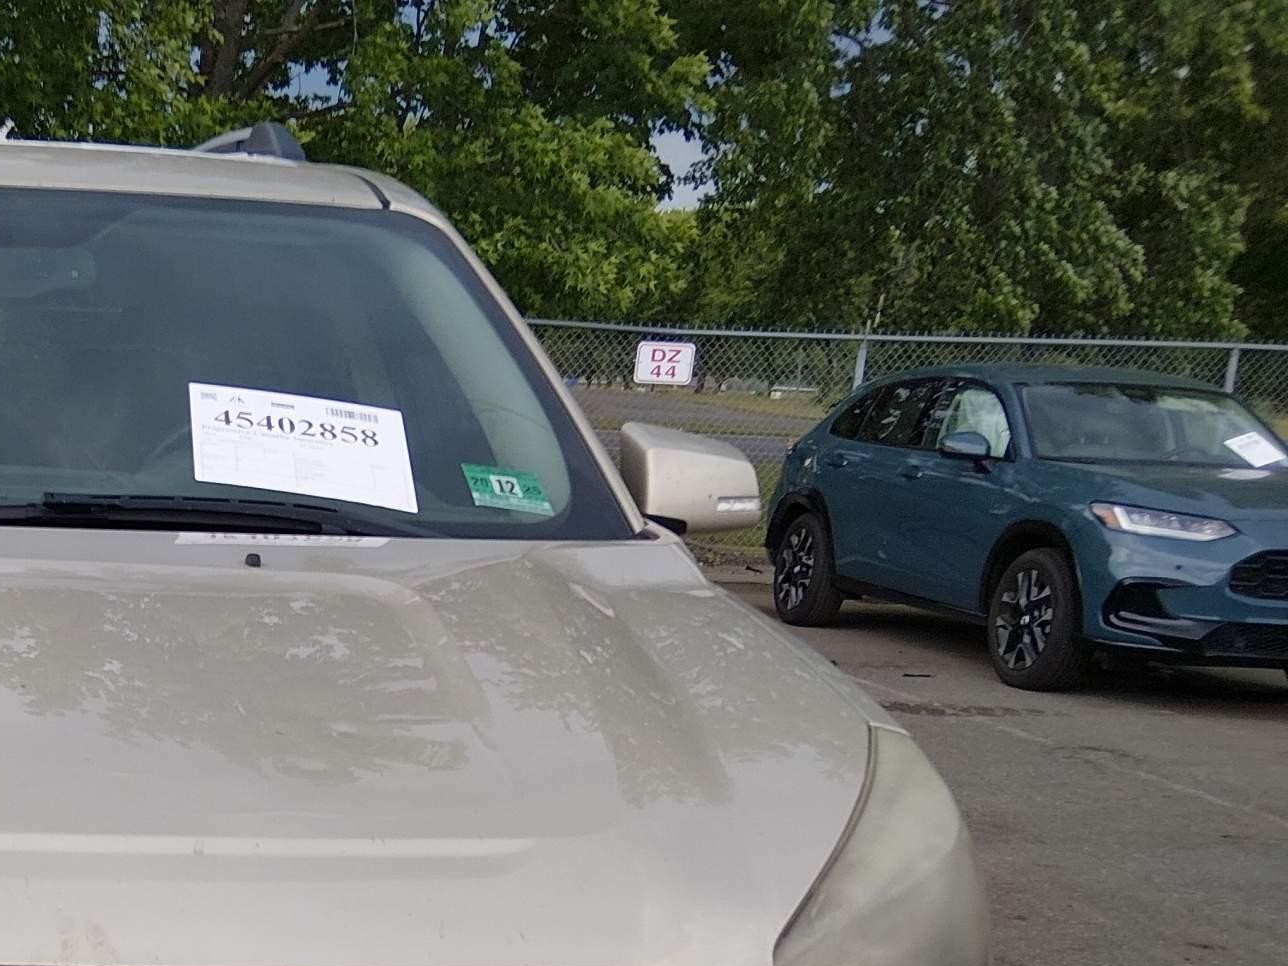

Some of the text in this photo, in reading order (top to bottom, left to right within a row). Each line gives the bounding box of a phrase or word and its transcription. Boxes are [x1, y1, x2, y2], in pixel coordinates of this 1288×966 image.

[651, 349, 682, 363] DZ
[650, 365, 677, 378] 44
[214, 409, 379, 447] 45402858
[495, 479, 518, 496] 12
